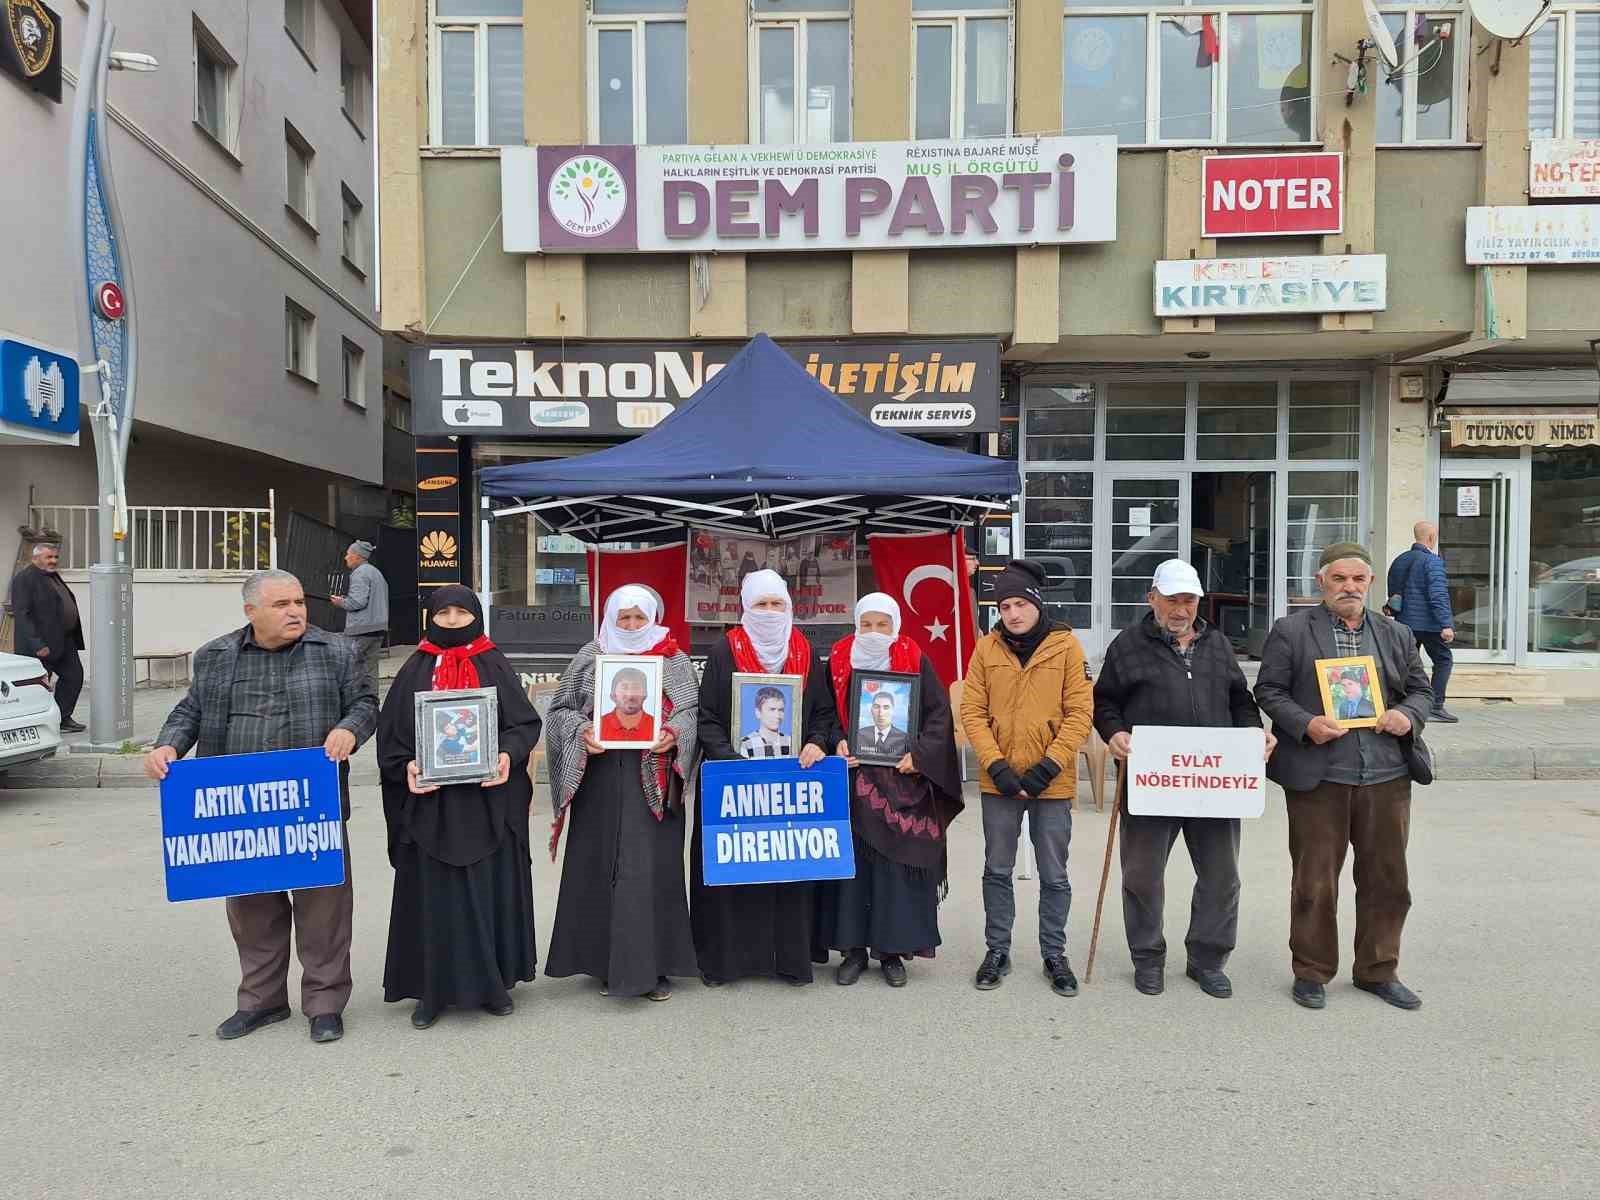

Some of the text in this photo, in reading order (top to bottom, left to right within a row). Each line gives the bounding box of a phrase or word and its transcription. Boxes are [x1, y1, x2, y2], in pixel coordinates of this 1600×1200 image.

[663, 162, 877, 178] HALKLARIN EŞİTLİK VE DEMOKRASİ PARTİSİ
[906, 163, 942, 177] MUŞ
[967, 158, 1039, 174] ÖRGÜTÜ
[663, 152, 1076, 240] DEM PARTİ
[1212, 177, 1333, 211] NOTER
[565, 219, 585, 233] DEM
[1161, 278, 1378, 308] KIRTASİYE
[429, 349, 977, 402] TeknoN İLETİŞİM
[874, 407, 973, 421] TEKNİK SERVİS
[1465, 420, 1595, 441] TÜTÜNCÜ NİMET
[423, 478, 453, 487] SAMSUNG
[420, 560, 458, 568] HUAWEI
[497, 608, 546, 621] Fatura
[1171, 754, 1223, 768] EVLAT
[1135, 771, 1259, 790] NÖBETİNDEYİZ
[194, 778, 310, 819] ARTIK YETER !
[720, 781, 824, 818] ANNELER
[164, 813, 342, 868] YAKAMIZDAN DÜŞÜN
[716, 821, 841, 864] DİRENİYOR
